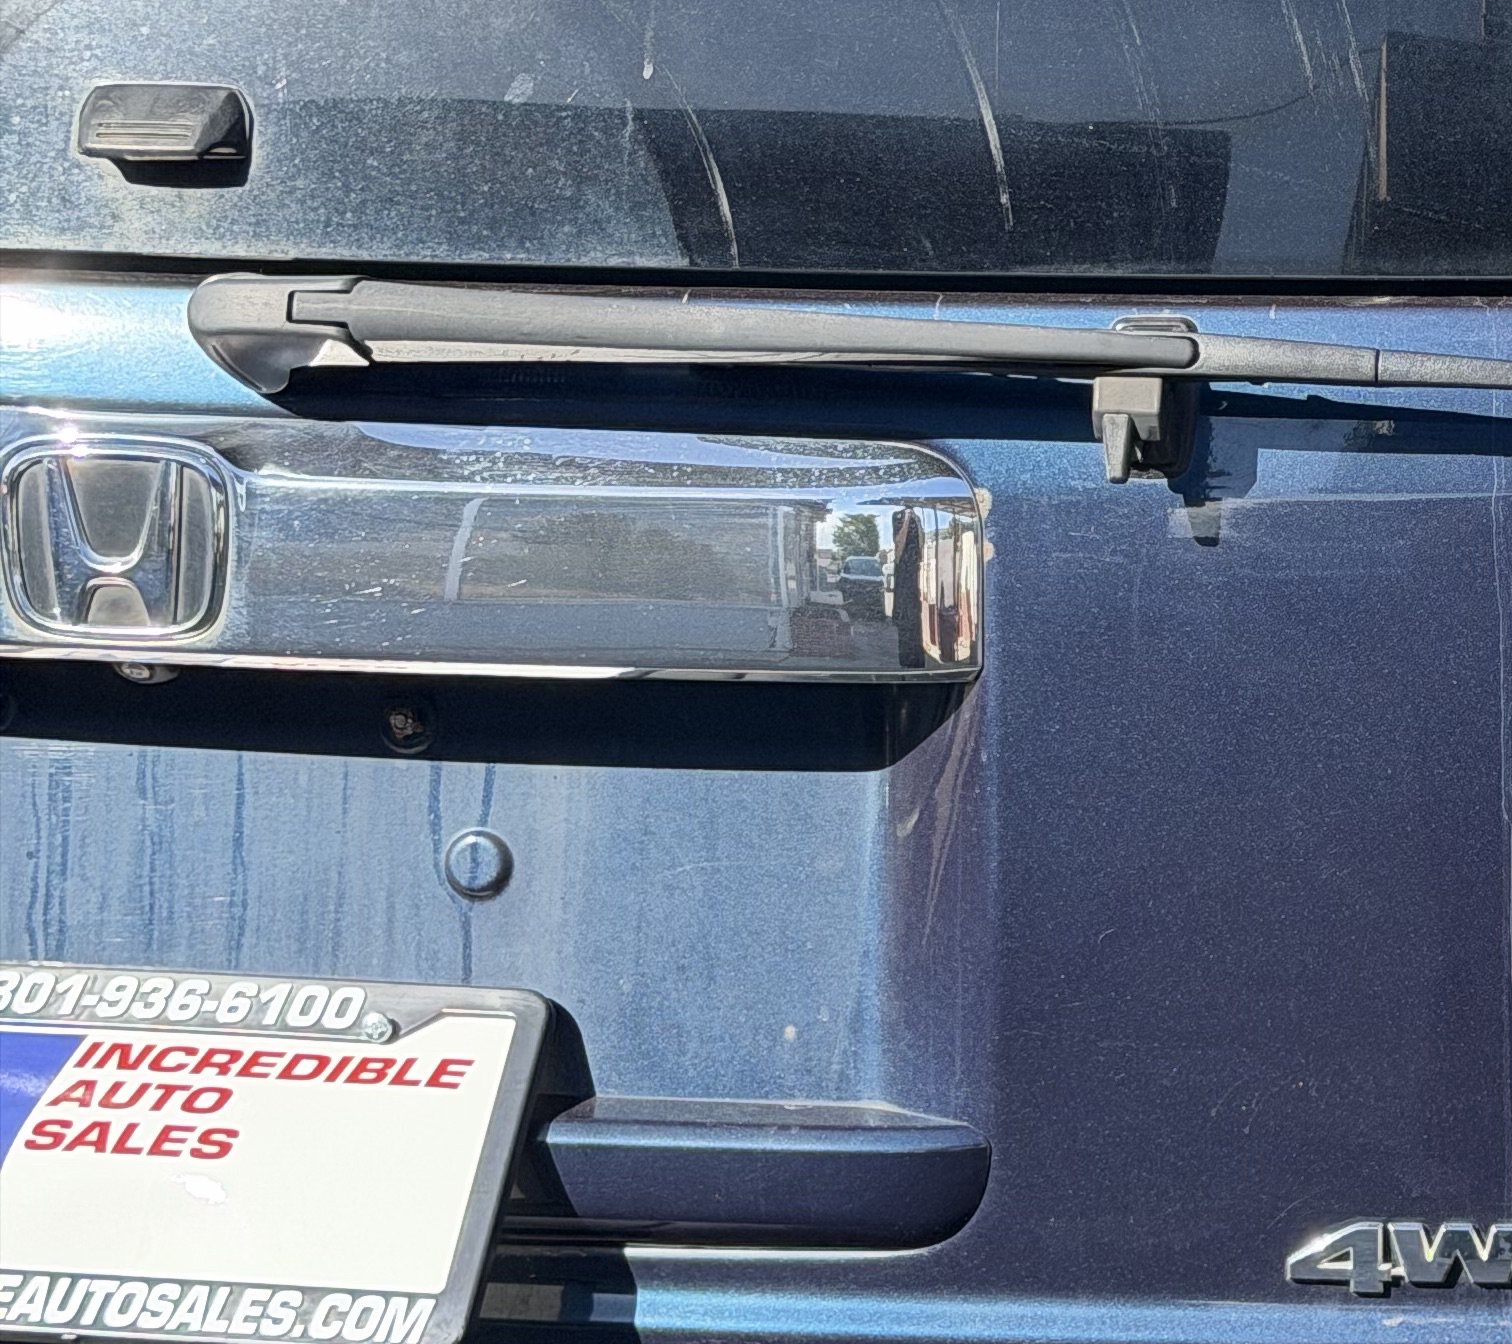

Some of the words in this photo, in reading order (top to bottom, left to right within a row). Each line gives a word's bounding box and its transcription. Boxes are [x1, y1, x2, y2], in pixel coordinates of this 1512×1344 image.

[73, 1041, 475, 1089] INCREDIBLE
[45, 1079, 233, 1114] AUTO
[24, 1119, 240, 1159] SALES
